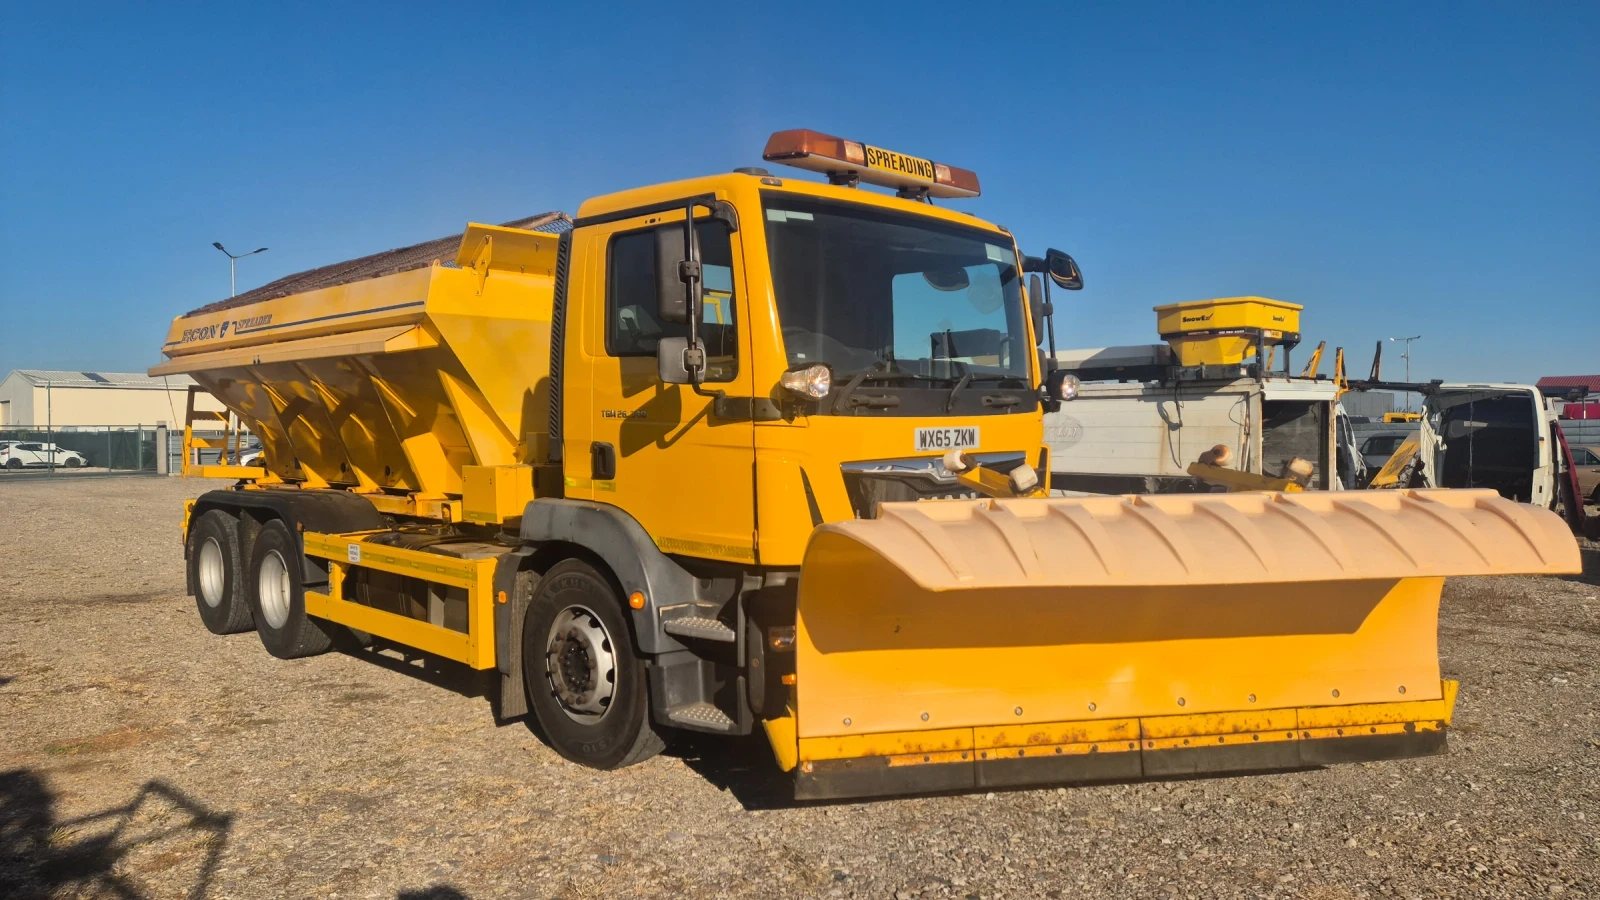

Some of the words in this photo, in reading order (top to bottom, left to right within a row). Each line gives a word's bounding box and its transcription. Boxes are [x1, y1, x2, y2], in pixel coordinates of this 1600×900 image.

[867, 147, 932, 178] SPREADING
[181, 324, 220, 343] ECON
[919, 429, 951, 448] WX65
[953, 428, 975, 447] ZKW
